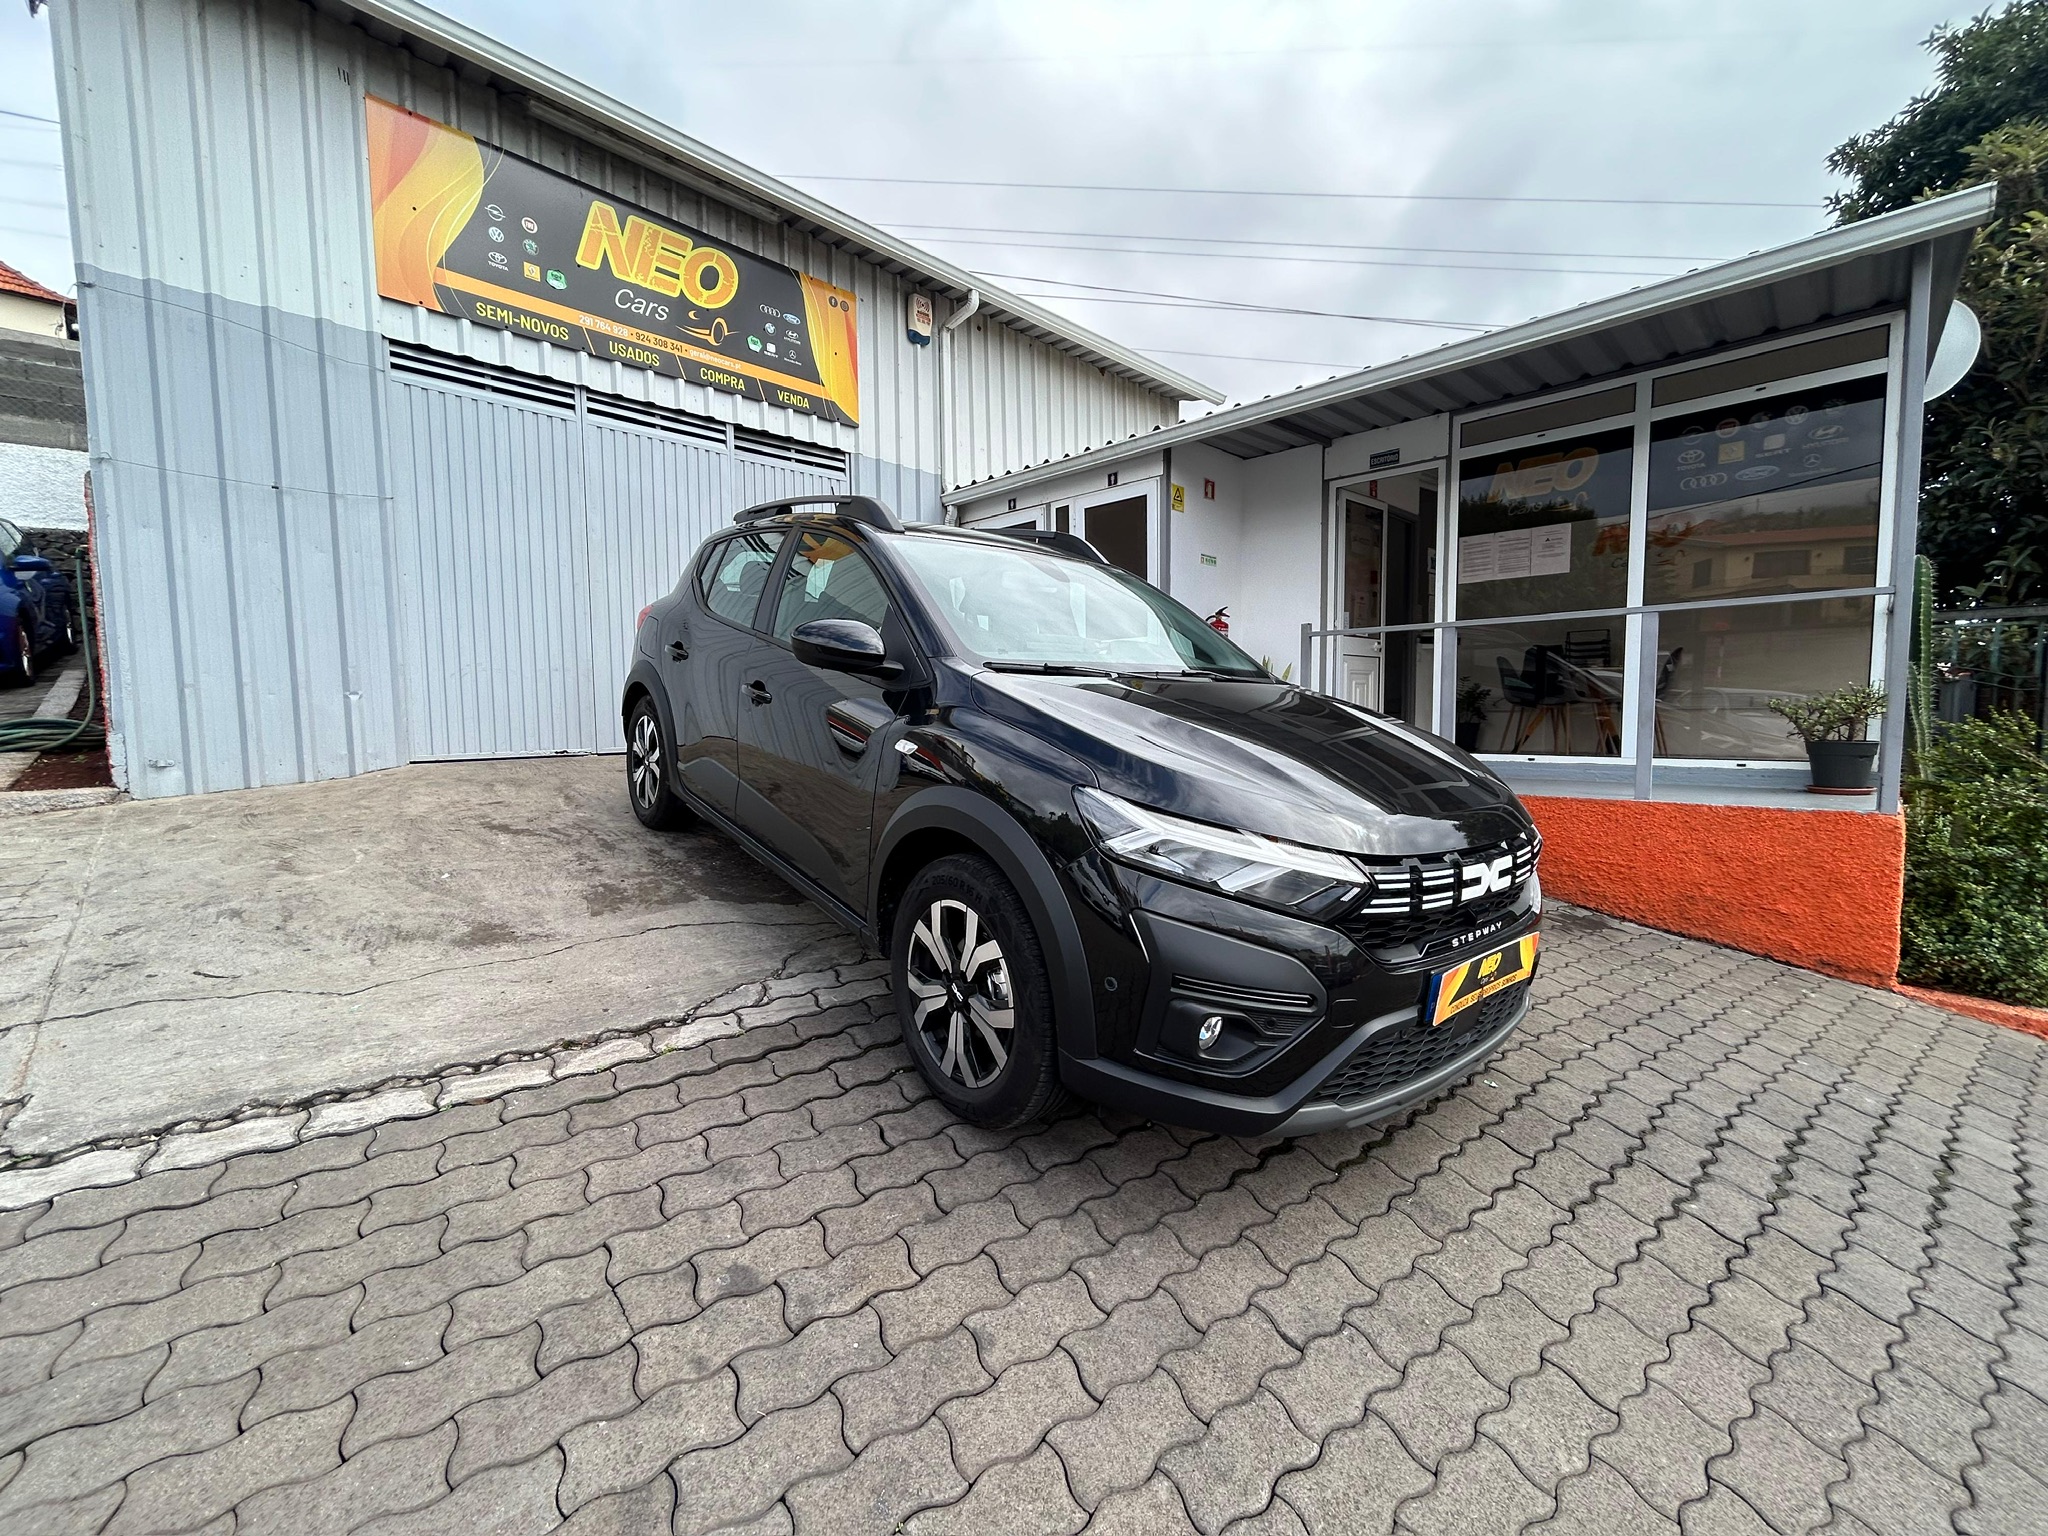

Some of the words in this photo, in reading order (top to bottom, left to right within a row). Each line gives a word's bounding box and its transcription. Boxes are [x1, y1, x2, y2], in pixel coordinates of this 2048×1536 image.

[488, 261, 509, 272] TOYOTA
[576, 200, 739, 309] NEO
[615, 289, 670, 321] Cars
[475, 302, 569, 341] SEMI-NOVOS
[579, 315, 594, 327] 291
[596, 320, 611, 332] 764
[613, 325, 629, 337] 928
[635, 332, 651, 344] 924
[653, 336, 668, 349] 308
[670, 342, 683, 353] 341
[609, 340, 660, 367] USADOS
[700, 367, 746, 391] COMPRA
[777, 389, 810, 409] VENDA
[1486, 447, 1599, 504] NEO
[1451, 921, 1503, 947] STEPWAY
[1477, 951, 1503, 979] NEO
